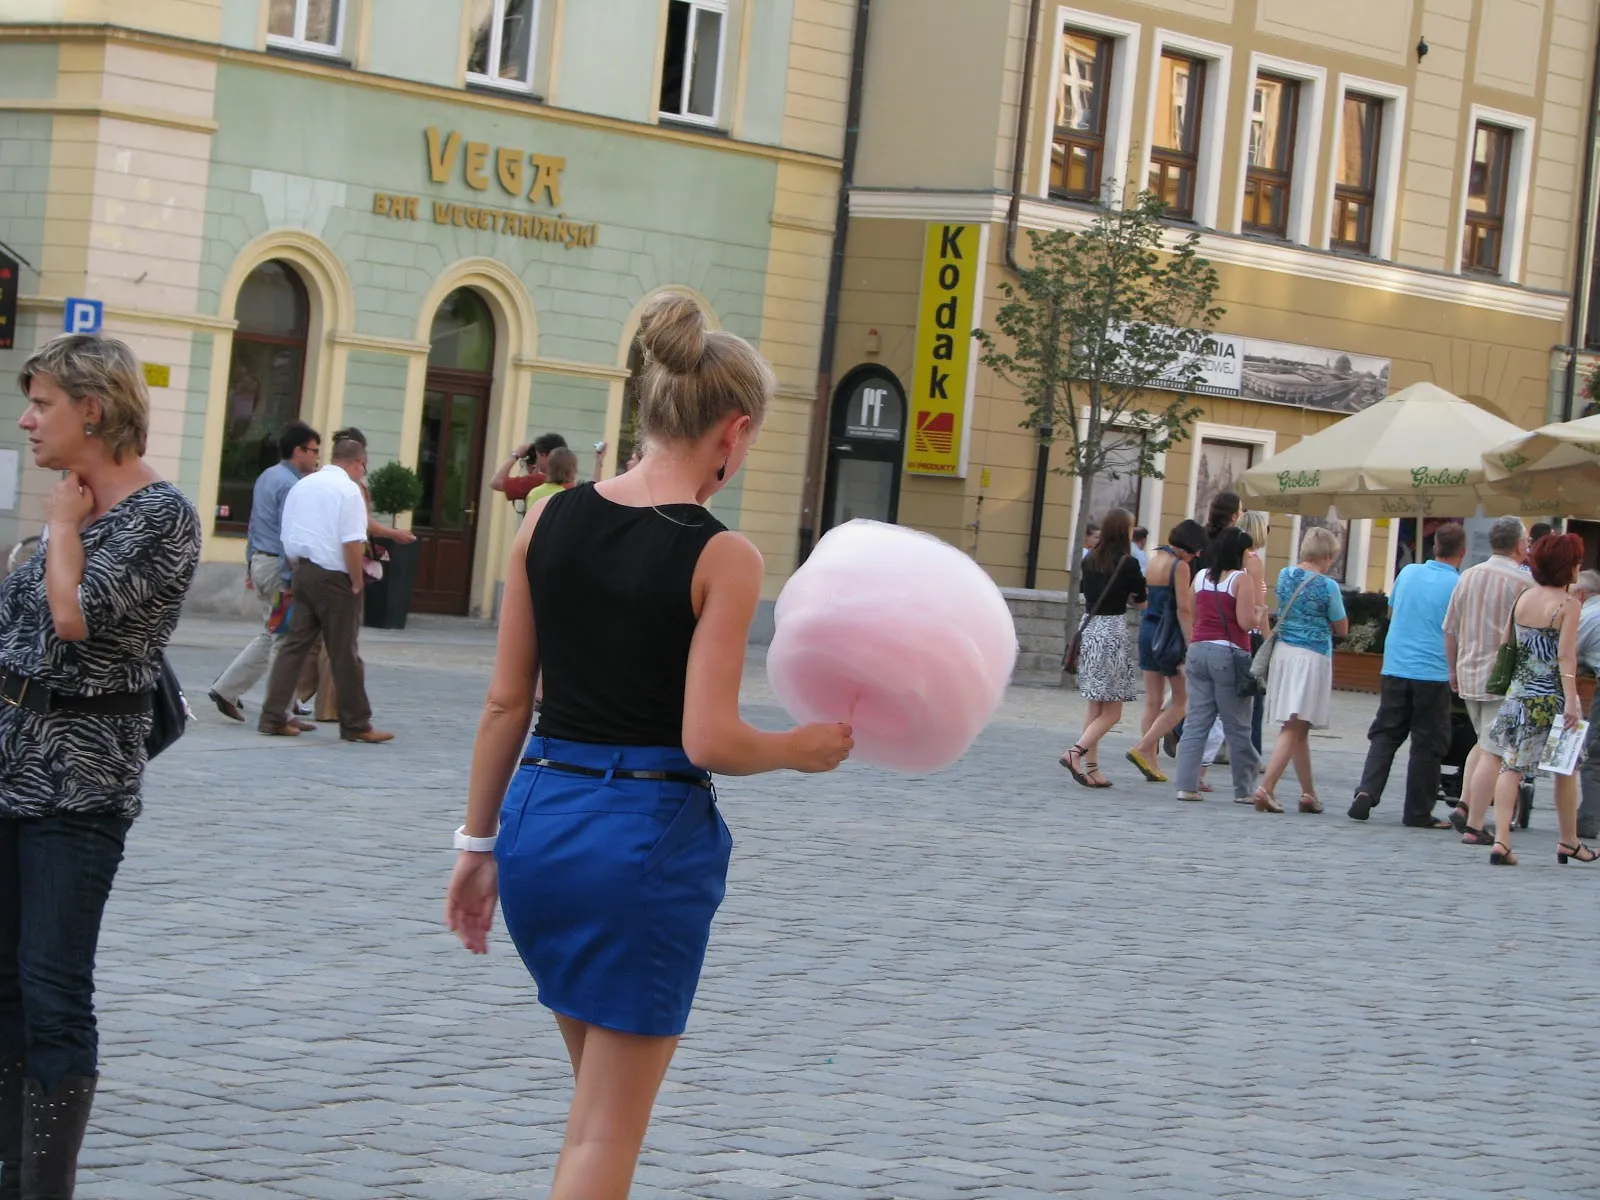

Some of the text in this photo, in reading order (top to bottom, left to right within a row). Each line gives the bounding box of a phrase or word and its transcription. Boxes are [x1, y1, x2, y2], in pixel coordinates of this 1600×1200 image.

[424, 125, 566, 208] VEGA
[373, 191, 420, 221] BAR
[72, 303, 96, 334] P
[929, 225, 965, 400] Kodak
[1277, 469, 1321, 493] Grolsch
[1411, 466, 1470, 488] Grolsch
